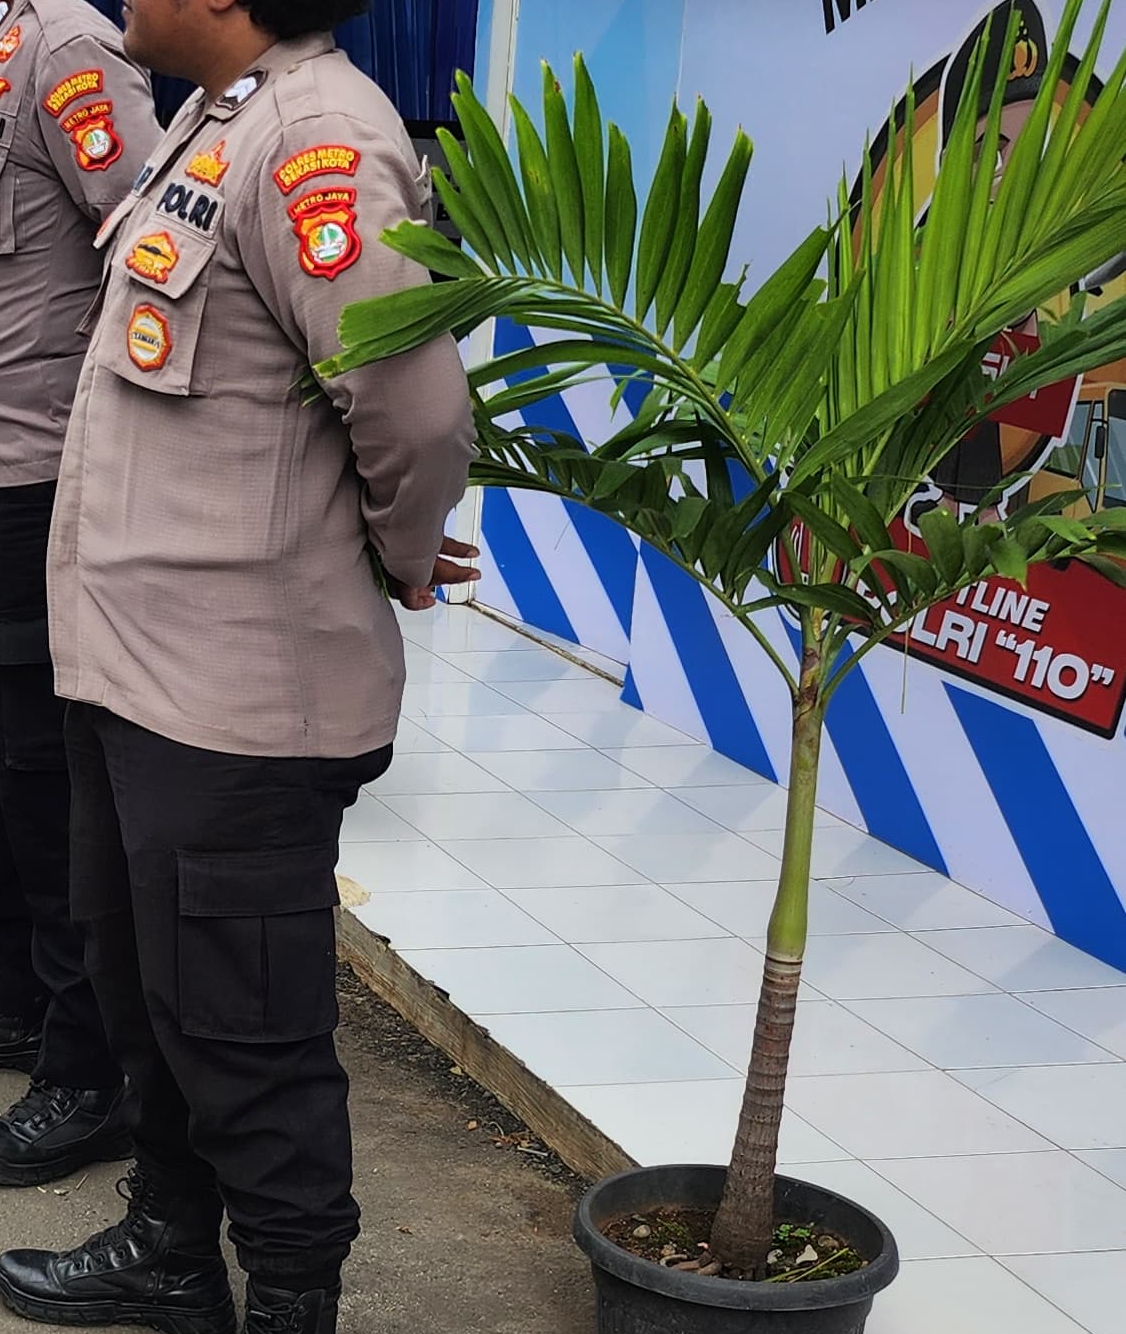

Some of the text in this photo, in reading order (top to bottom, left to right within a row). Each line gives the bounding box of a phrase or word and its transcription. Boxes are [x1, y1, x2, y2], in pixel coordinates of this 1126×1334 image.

[317, 148, 355, 162] METRO
[156, 181, 219, 232] POLRI
[293, 192, 350, 214] METRO JAYA
[956, 578, 1050, 633] TLINE
